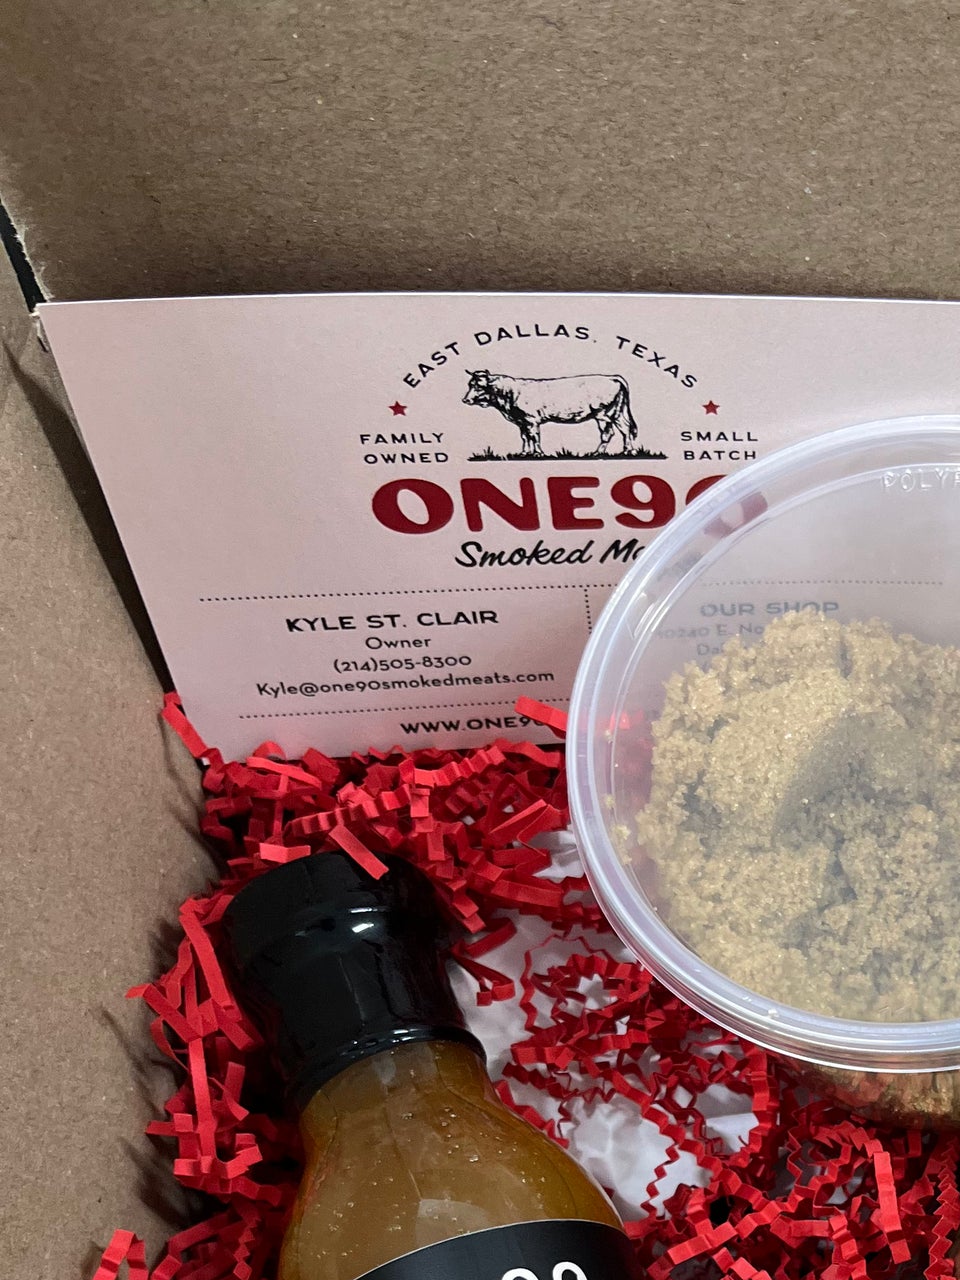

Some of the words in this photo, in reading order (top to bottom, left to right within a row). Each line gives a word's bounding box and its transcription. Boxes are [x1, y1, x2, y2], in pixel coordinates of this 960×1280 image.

[402, 341, 460, 389] EAST
[616, 335, 698, 388] TEXAS
[360, 432, 444, 445] FAMILY
[680, 431, 758, 442] SMALL
[363, 452, 449, 465] OWNED
[683, 450, 757, 461] BATCH
[455, 540, 593, 568] Smoked
[700, 603, 755, 617] OUR
[285, 615, 357, 632] KYLE
[366, 613, 407, 629] ST.
[416, 610, 499, 627] CLAIR
[365, 636, 432, 650] Owner
[333, 655, 472, 674] (214)505-8300
[256, 670, 555, 698] Kyle@one90smokedmeats.com
